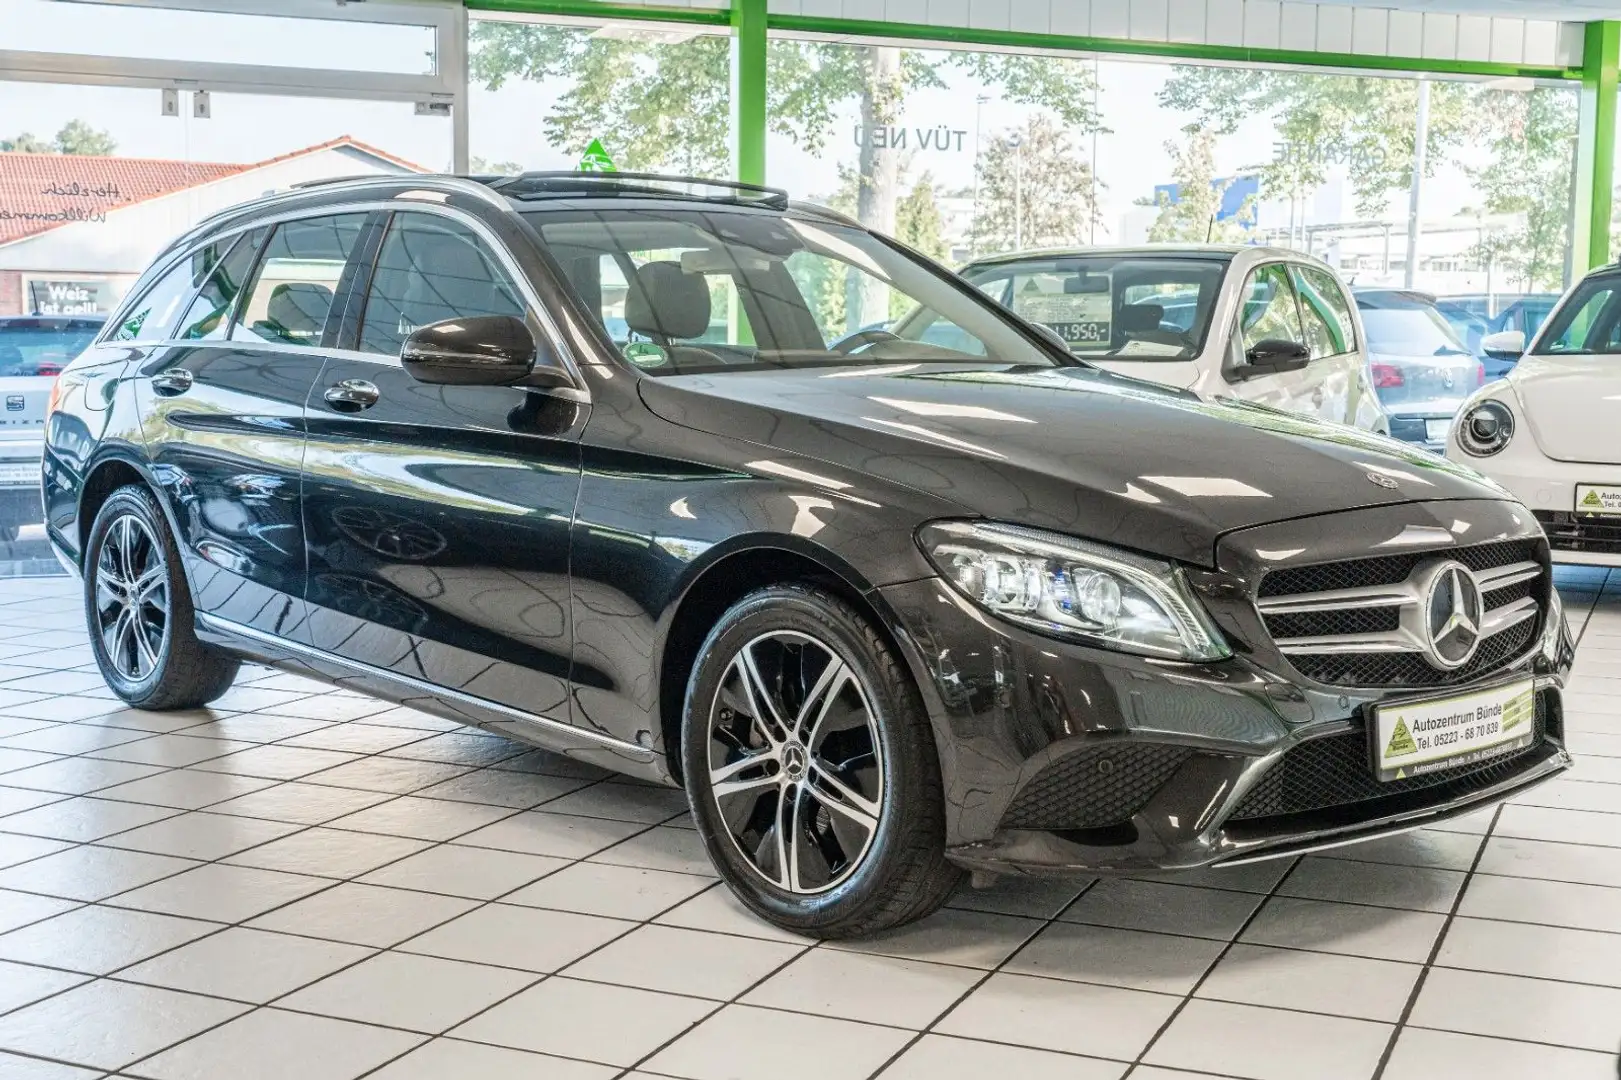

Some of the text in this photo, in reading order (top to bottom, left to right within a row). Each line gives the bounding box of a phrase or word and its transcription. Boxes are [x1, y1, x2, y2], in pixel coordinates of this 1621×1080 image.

[1412, 711, 1475, 733] Autozentrum
[1476, 703, 1502, 720] Bünde
[1417, 736, 1432, 750] Tel.
[1434, 731, 1458, 747] 05223
[1465, 727, 1475, 740] 68
[1476, 724, 1485, 737] 70
[1486, 721, 1498, 735] 839
